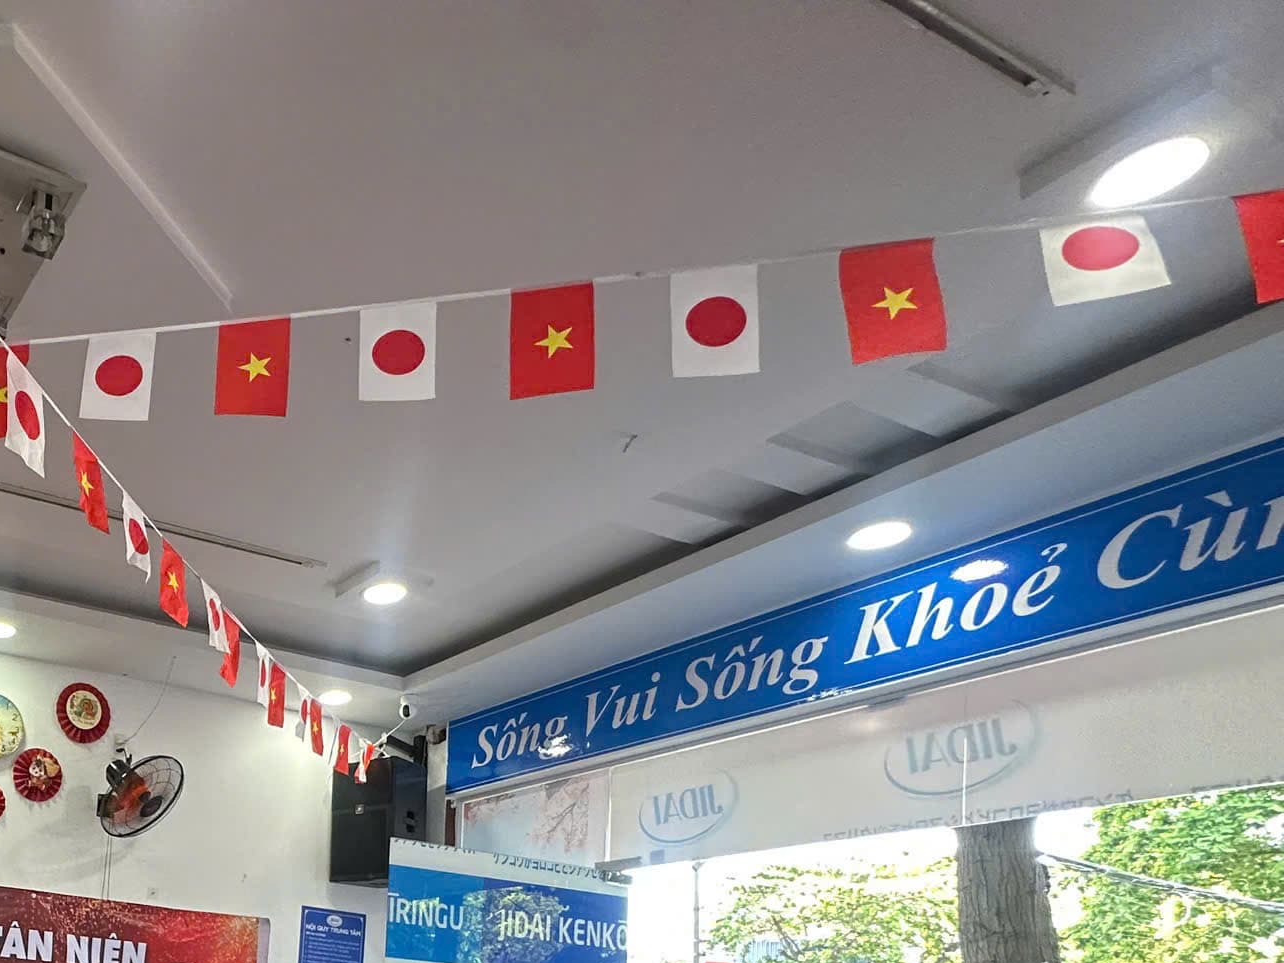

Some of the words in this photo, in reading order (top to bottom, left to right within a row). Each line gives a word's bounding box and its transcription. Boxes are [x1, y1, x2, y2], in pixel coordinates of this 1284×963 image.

[471, 711, 569, 769] Sống
[585, 671, 661, 737] Vui
[675, 636, 829, 713] Sống
[844, 542, 1068, 665] Khoẻ
